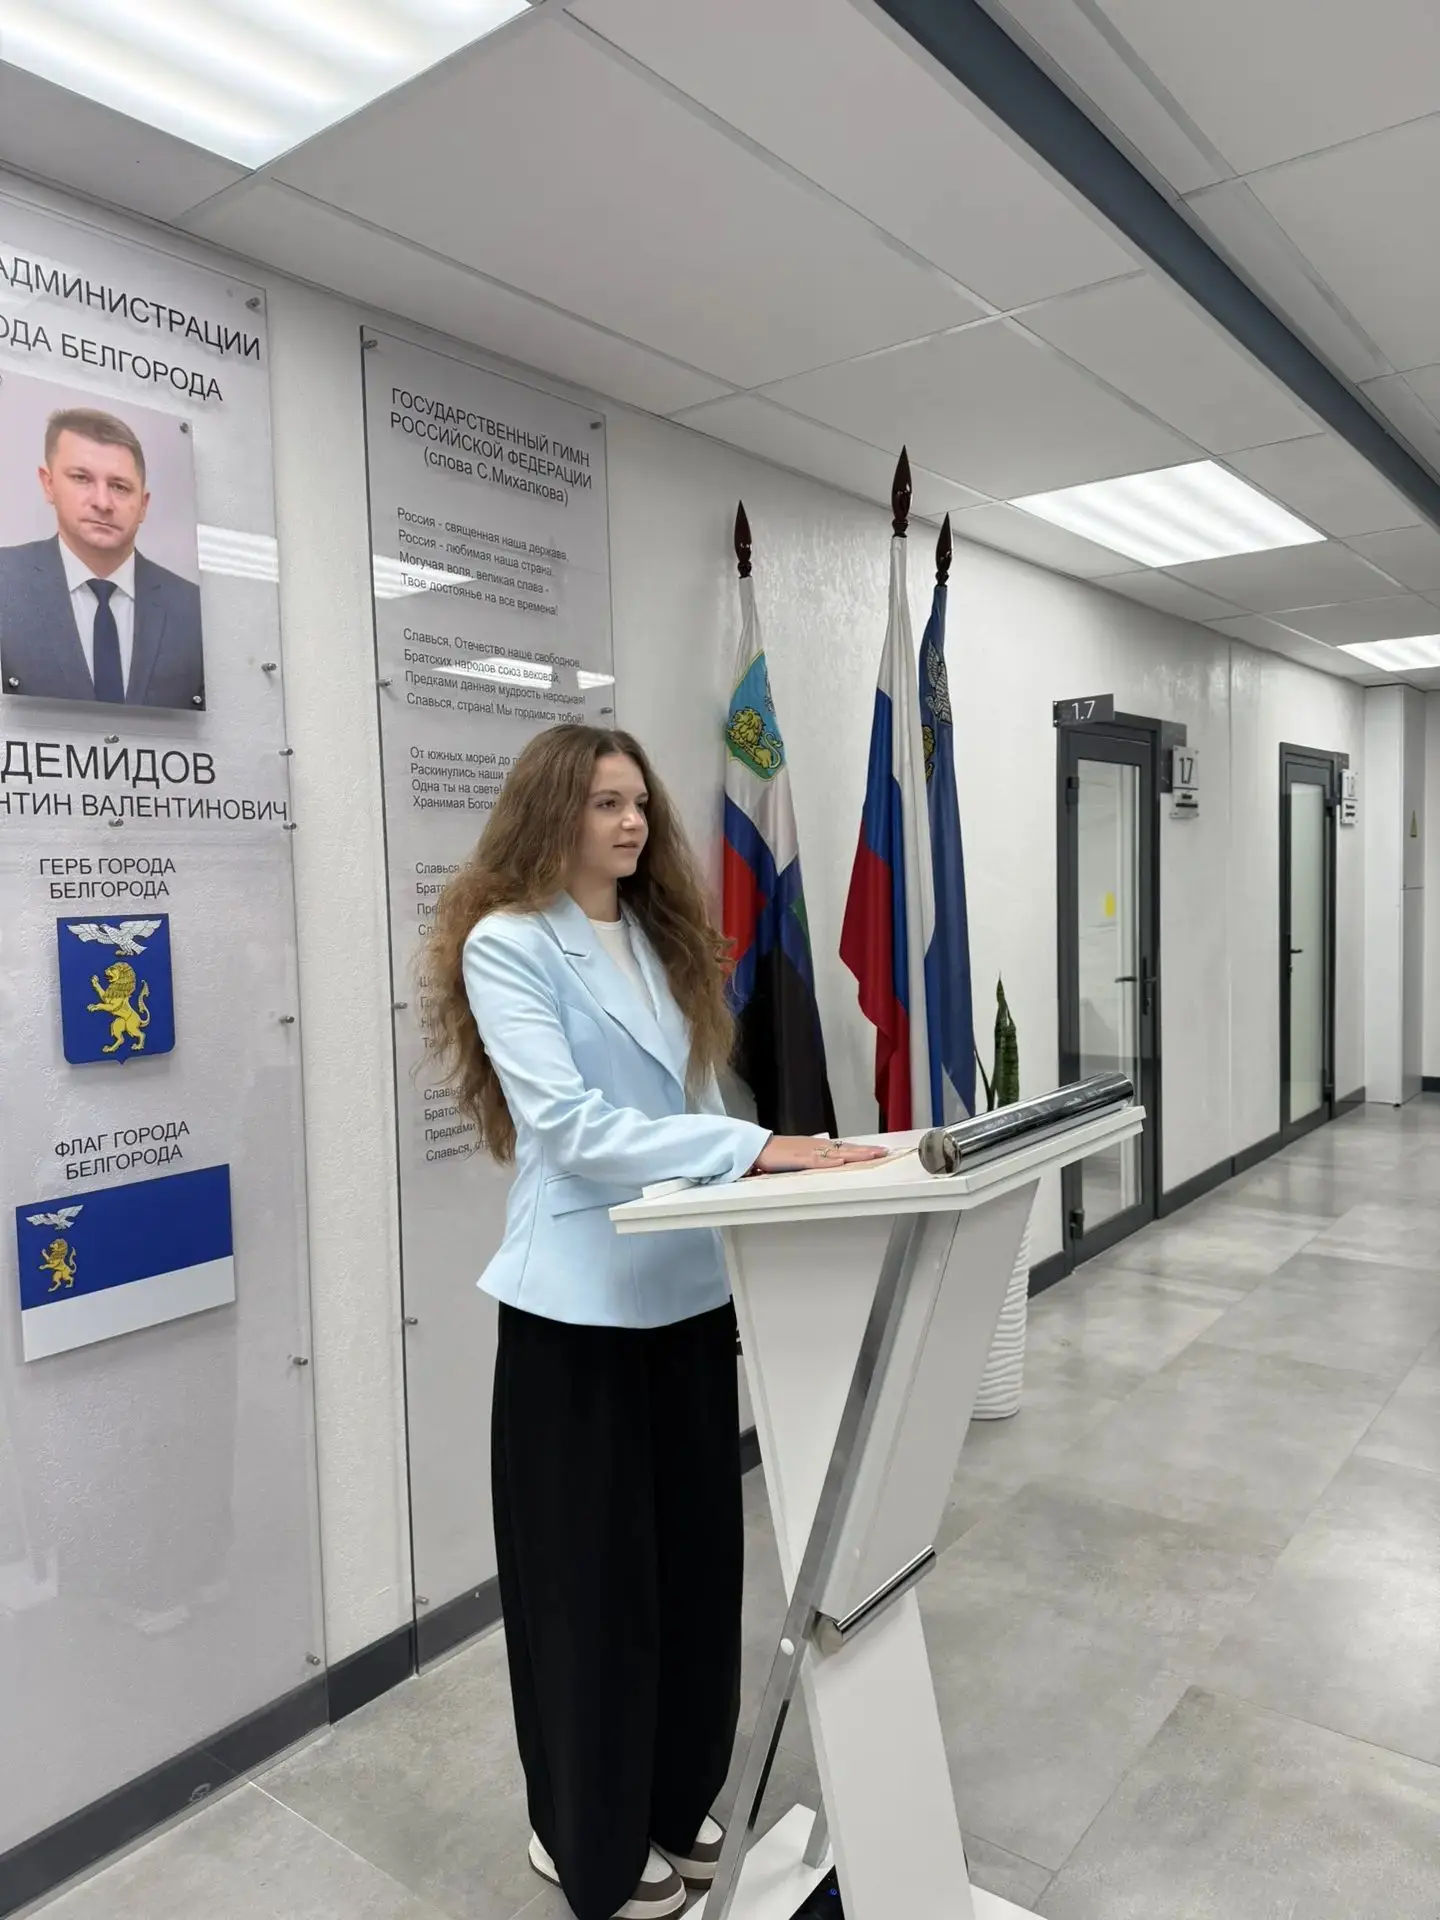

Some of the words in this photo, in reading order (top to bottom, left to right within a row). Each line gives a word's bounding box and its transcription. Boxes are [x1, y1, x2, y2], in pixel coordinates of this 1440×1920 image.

[61, 333, 224, 402] БЕЛГОРОДА
[392, 388, 549, 454] ГОСУДАРСТВЕННЫЙ
[552, 441, 590, 468] ГИМН
[390, 411, 504, 462] РОССИЙСКОЙ
[507, 449, 592, 490] ФЕДЕРАЦИИ
[424, 446, 473, 475] (слова
[476, 462, 568, 508] С.Михалкова)
[397, 507, 436, 527] Россия
[444, 522, 500, 544] священная
[501, 536, 527, 550] наша
[398, 529, 436, 549] Россия
[445, 543, 491, 561] любимая
[494, 555, 519, 568] наша
[399, 551, 444, 571] Могучая
[447, 564, 474, 579] воля,
[476, 570, 515, 587] великая
[517, 580, 543, 593] слава
[401, 572, 427, 589] Твое
[429, 581, 482, 601] достоянье
[484, 593, 497, 603] на
[499, 595, 515, 607] все
[403, 627, 452, 648] Славься,
[454, 636, 506, 656] Отечество
[508, 648, 533, 660] наше
[404, 648, 452, 666] Братских
[454, 660, 496, 673] народов
[498, 666, 521, 678] союз
[405, 670, 458, 688] Предками
[460, 680, 496, 694] данная
[498, 685, 541, 700] мудрость
[406, 692, 455, 711] Славься,
[456, 700, 494, 714] страна!
[496, 703, 512, 716] Мы
[514, 708, 556, 720] гордимся
[1071, 699, 1096, 720] 1.7
[1, 740, 216, 789] ДЕМИДОВ
[410, 746, 425, 759] От
[427, 750, 463, 761] южных
[465, 753, 497, 766] морей
[498, 756, 510, 766] до
[410, 762, 476, 780] Раскинулись
[478, 768, 504, 780] наши
[411, 779, 440, 793] Одна
[442, 783, 456, 793] ты
[458, 783, 471, 793] на
[82, 794, 288, 821] ВАЛЕНТИНОВИЧ
[413, 795, 466, 810] Хранимая
[40, 858, 92, 875] ГЕРБ
[98, 857, 176, 876] ГОРОДА
[50, 881, 170, 899] БЕЛГОРОДА
[54, 1134, 108, 1158] ФЛАГ
[114, 1121, 190, 1148] ГОРОДА
[426, 1143, 473, 1162] Славься,
[66, 1144, 183, 1180] БЕЛГОРОДА
